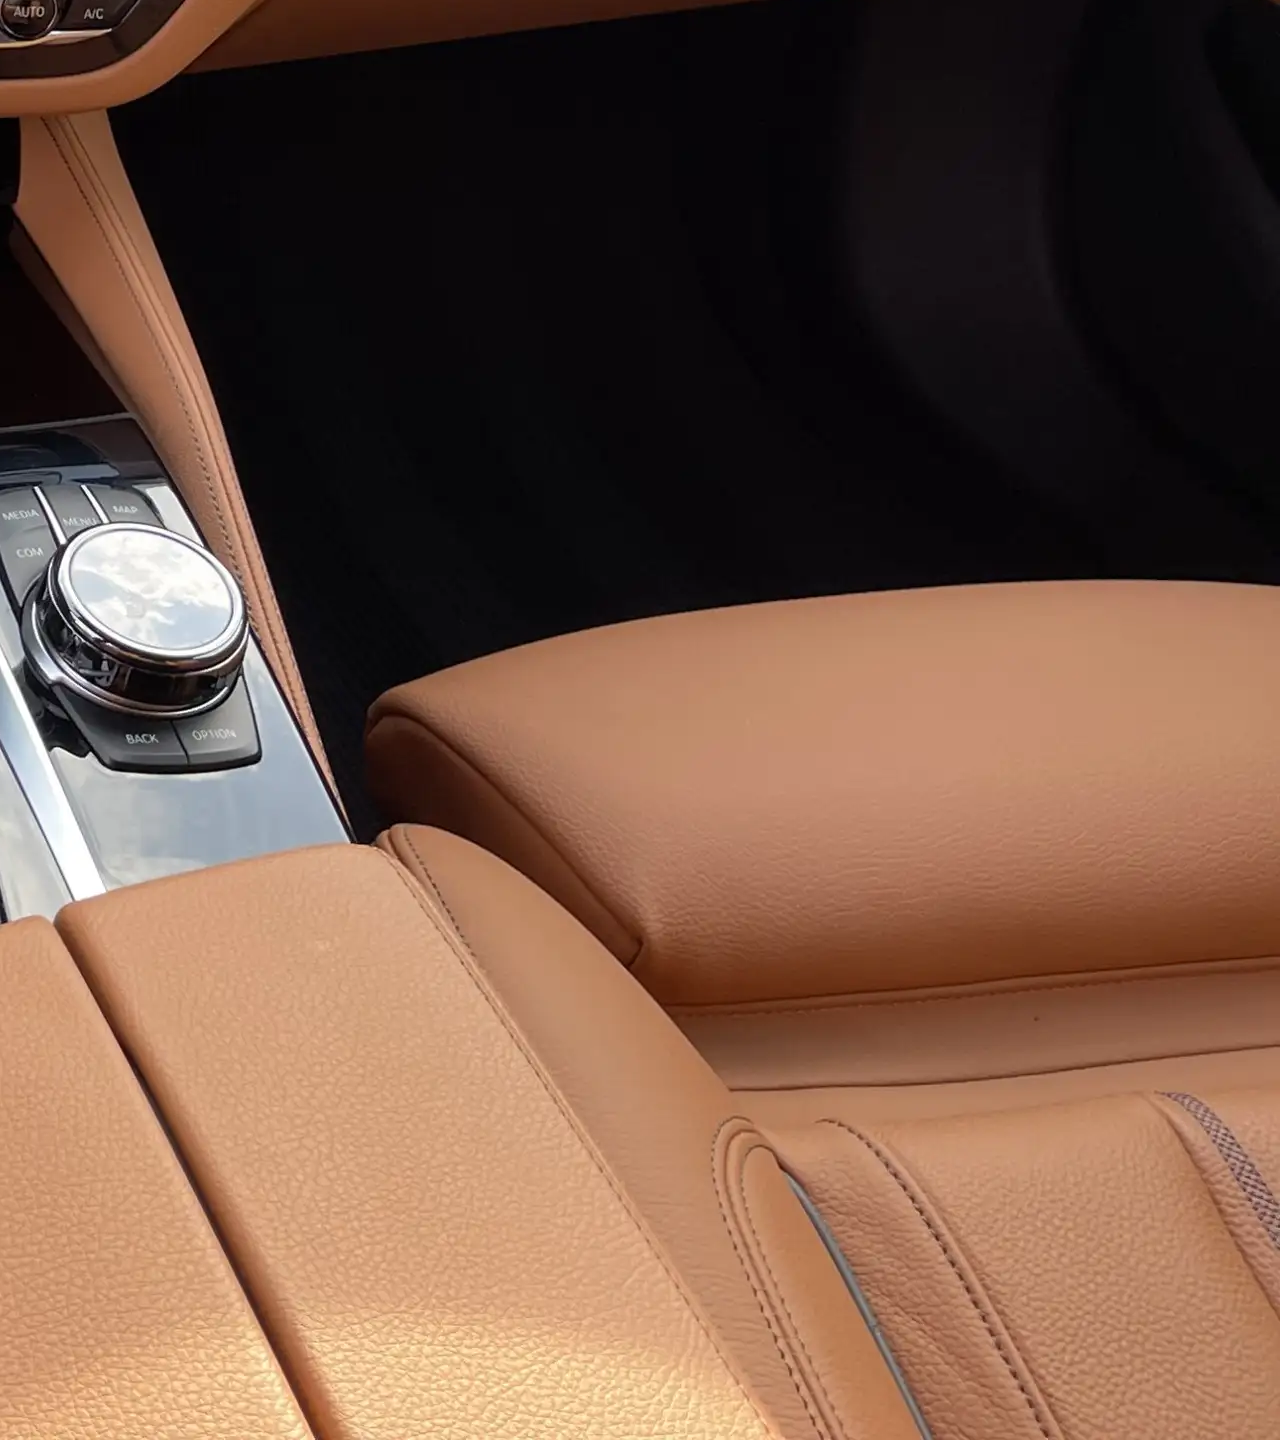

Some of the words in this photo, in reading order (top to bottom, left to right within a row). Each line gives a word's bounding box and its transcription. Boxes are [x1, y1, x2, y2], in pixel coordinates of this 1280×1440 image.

[14, 6, 45, 18] AUTO
[84, 8, 104, 20] A/C
[2, 509, 40, 522] MEDIA
[113, 505, 138, 515] MAP
[62, 516, 97, 527] MENU
[16, 548, 44, 559] COM
[125, 734, 159, 745] BACK
[192, 728, 237, 742] OPTION
